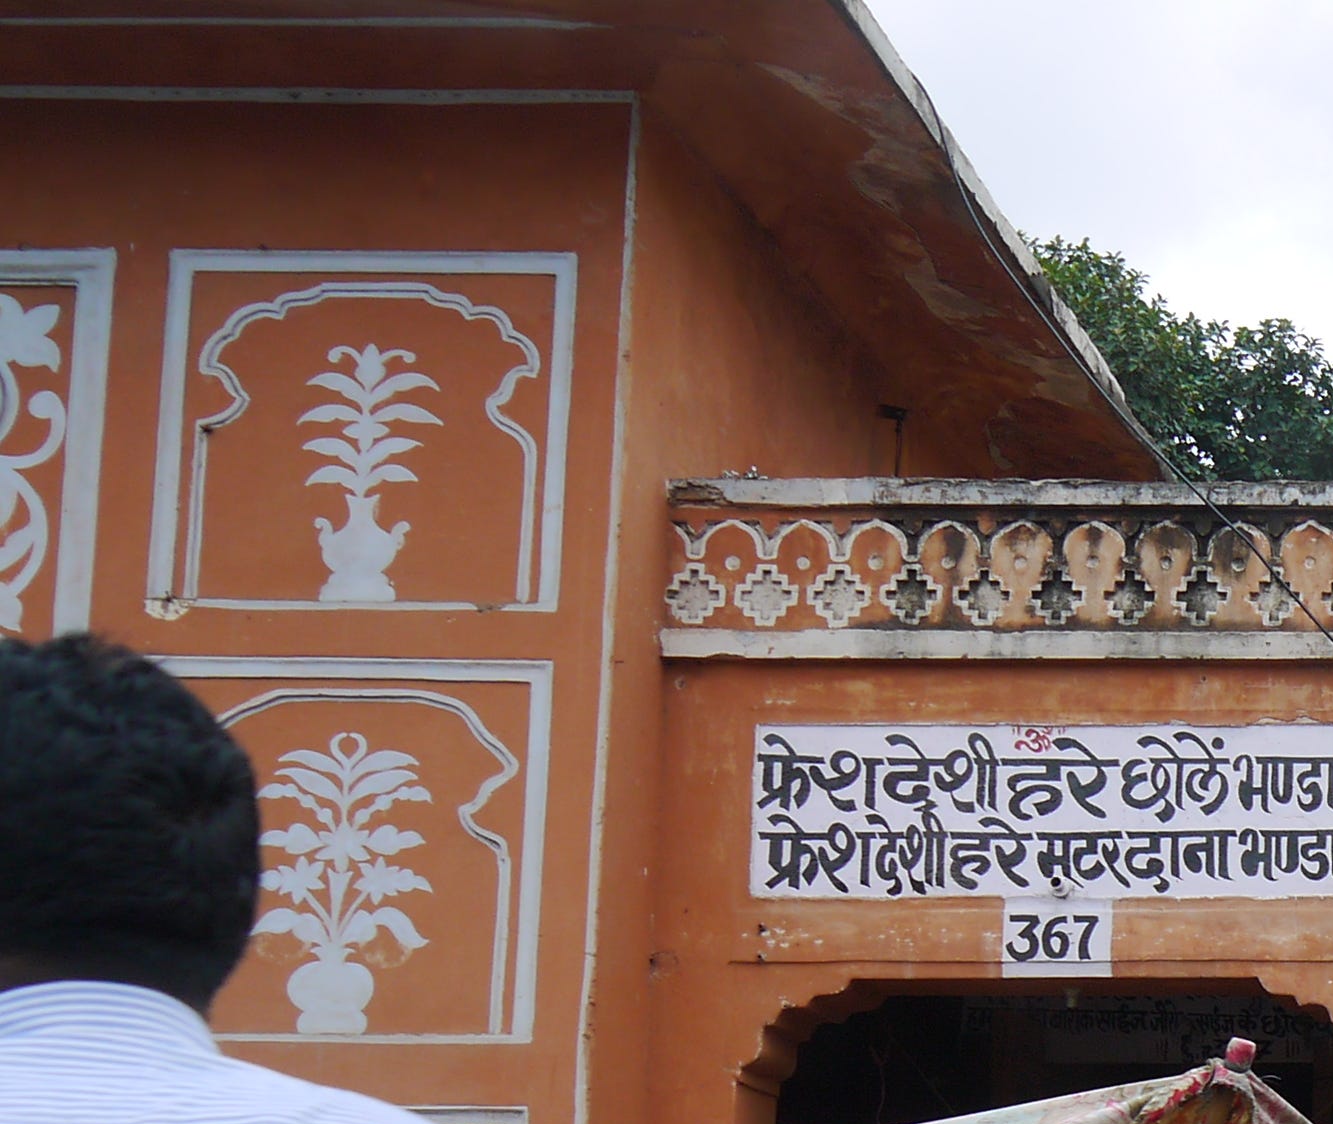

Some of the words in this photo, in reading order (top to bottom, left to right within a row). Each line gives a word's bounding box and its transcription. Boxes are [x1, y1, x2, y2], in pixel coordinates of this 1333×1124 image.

[757, 733, 884, 812] फ्रेश
[883, 732, 999, 815] देशी
[1000, 737, 1120, 821] हरे
[1121, 731, 1230, 823] छोलें
[758, 814, 877, 893] फ्रेश
[865, 810, 949, 895] देशी
[950, 817, 1033, 890] हरे
[1035, 831, 1130, 888] मटर
[1125, 830, 1237, 893] दाना
[1005, 914, 1099, 962] 367
